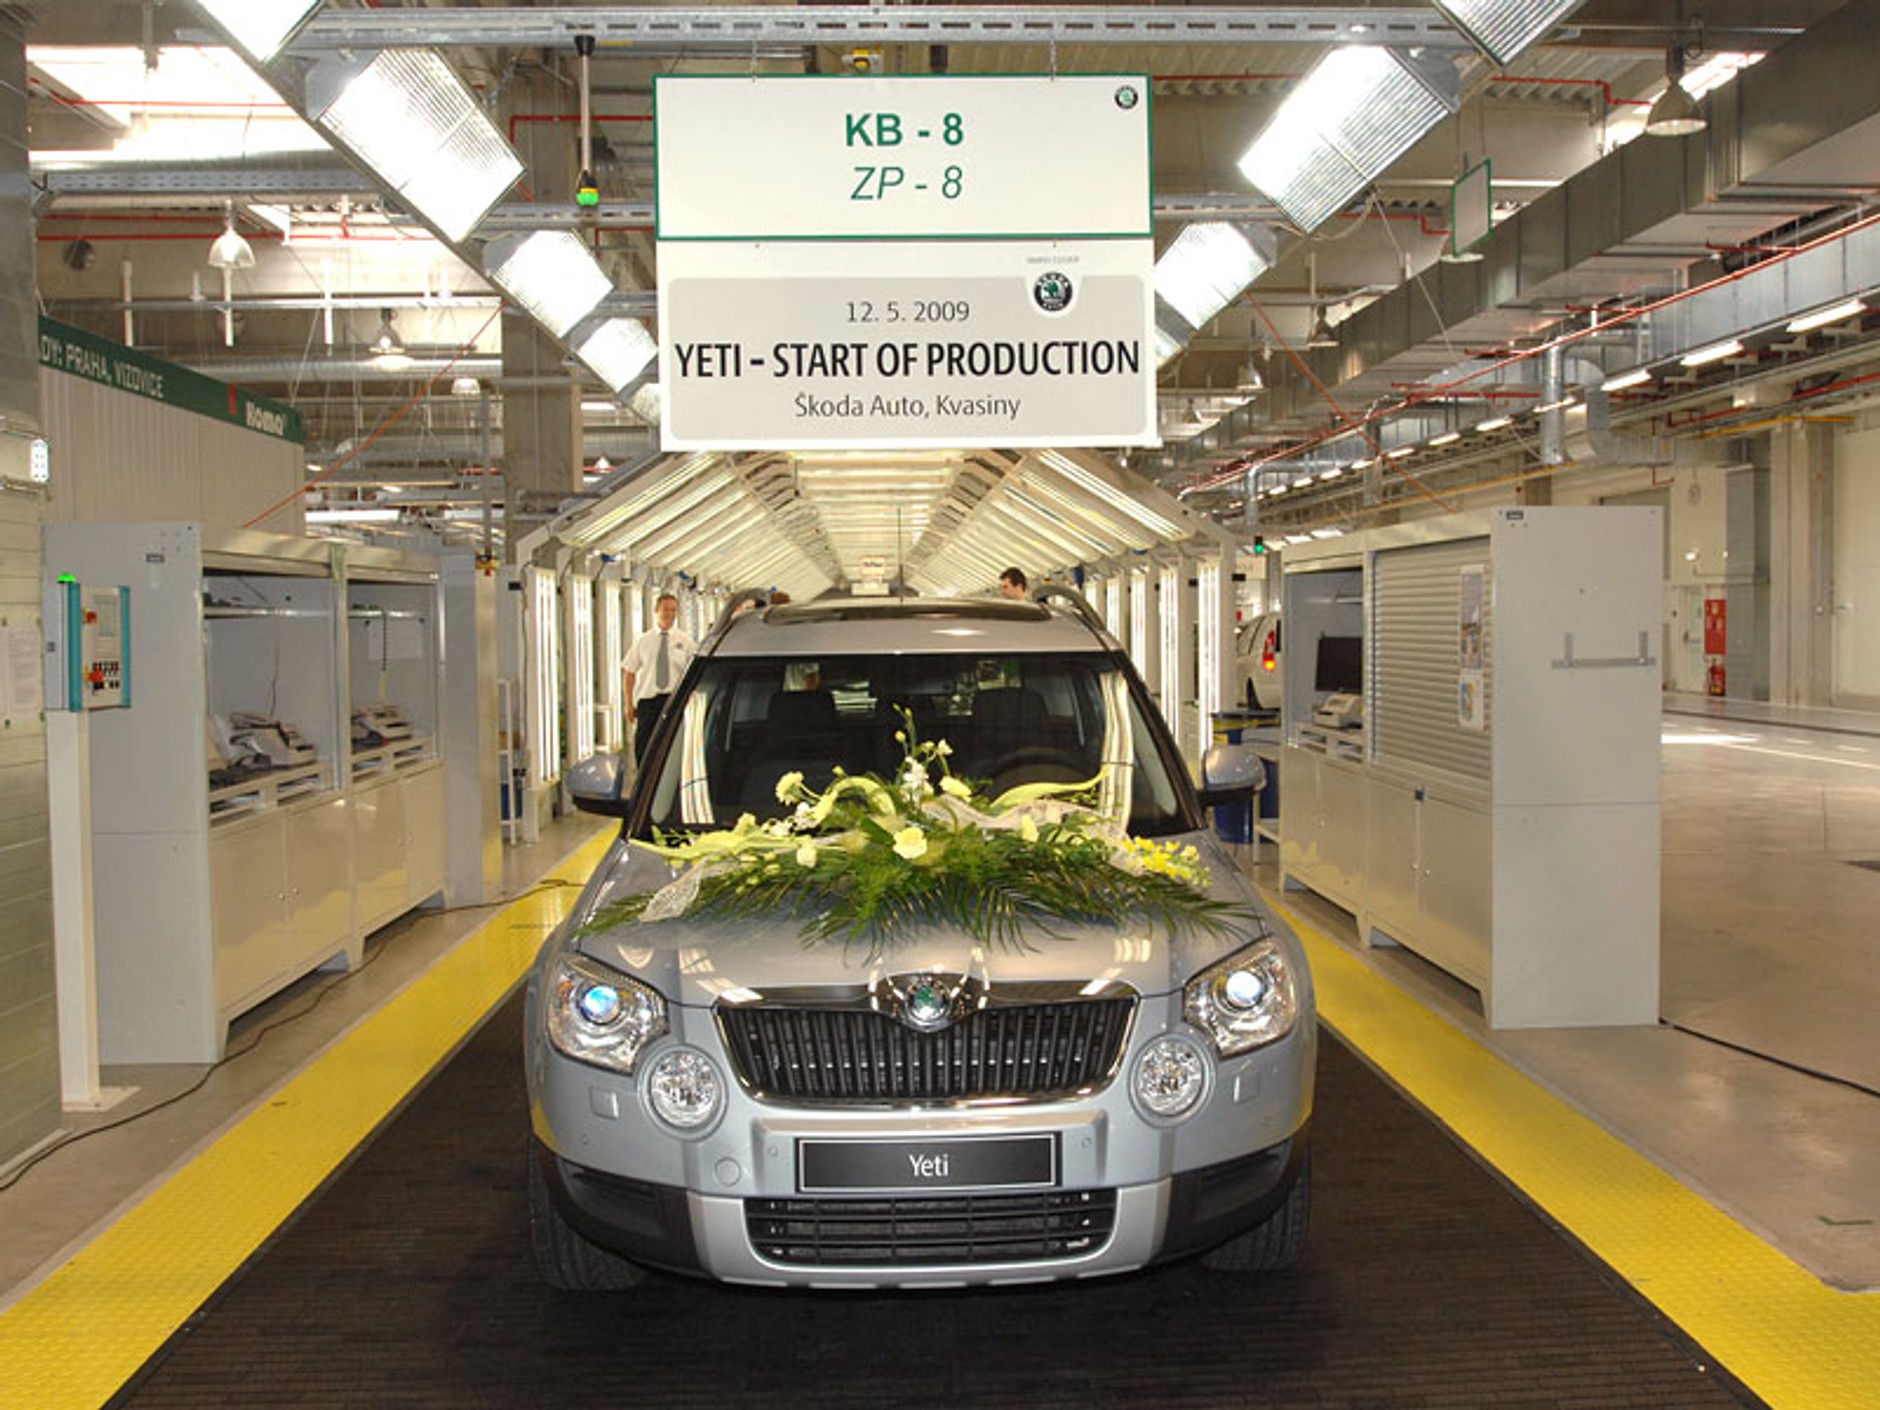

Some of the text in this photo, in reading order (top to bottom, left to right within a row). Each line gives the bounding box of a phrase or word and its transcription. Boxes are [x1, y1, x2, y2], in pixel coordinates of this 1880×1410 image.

[845, 112, 904, 148] KB
[942, 112, 964, 147] 8
[850, 166, 905, 201] ZP
[941, 164, 963, 200] 8
[847, 300, 970, 323] 12. 5. 2009
[674, 343, 741, 378] YETI
[772, 342, 869, 378] START
[876, 342, 919, 378] OF
[926, 340, 1140, 377] PRODUCTION
[794, 393, 1021, 421] Škoda Auto, Kvasiny
[908, 1153, 950, 1177] Yeti
